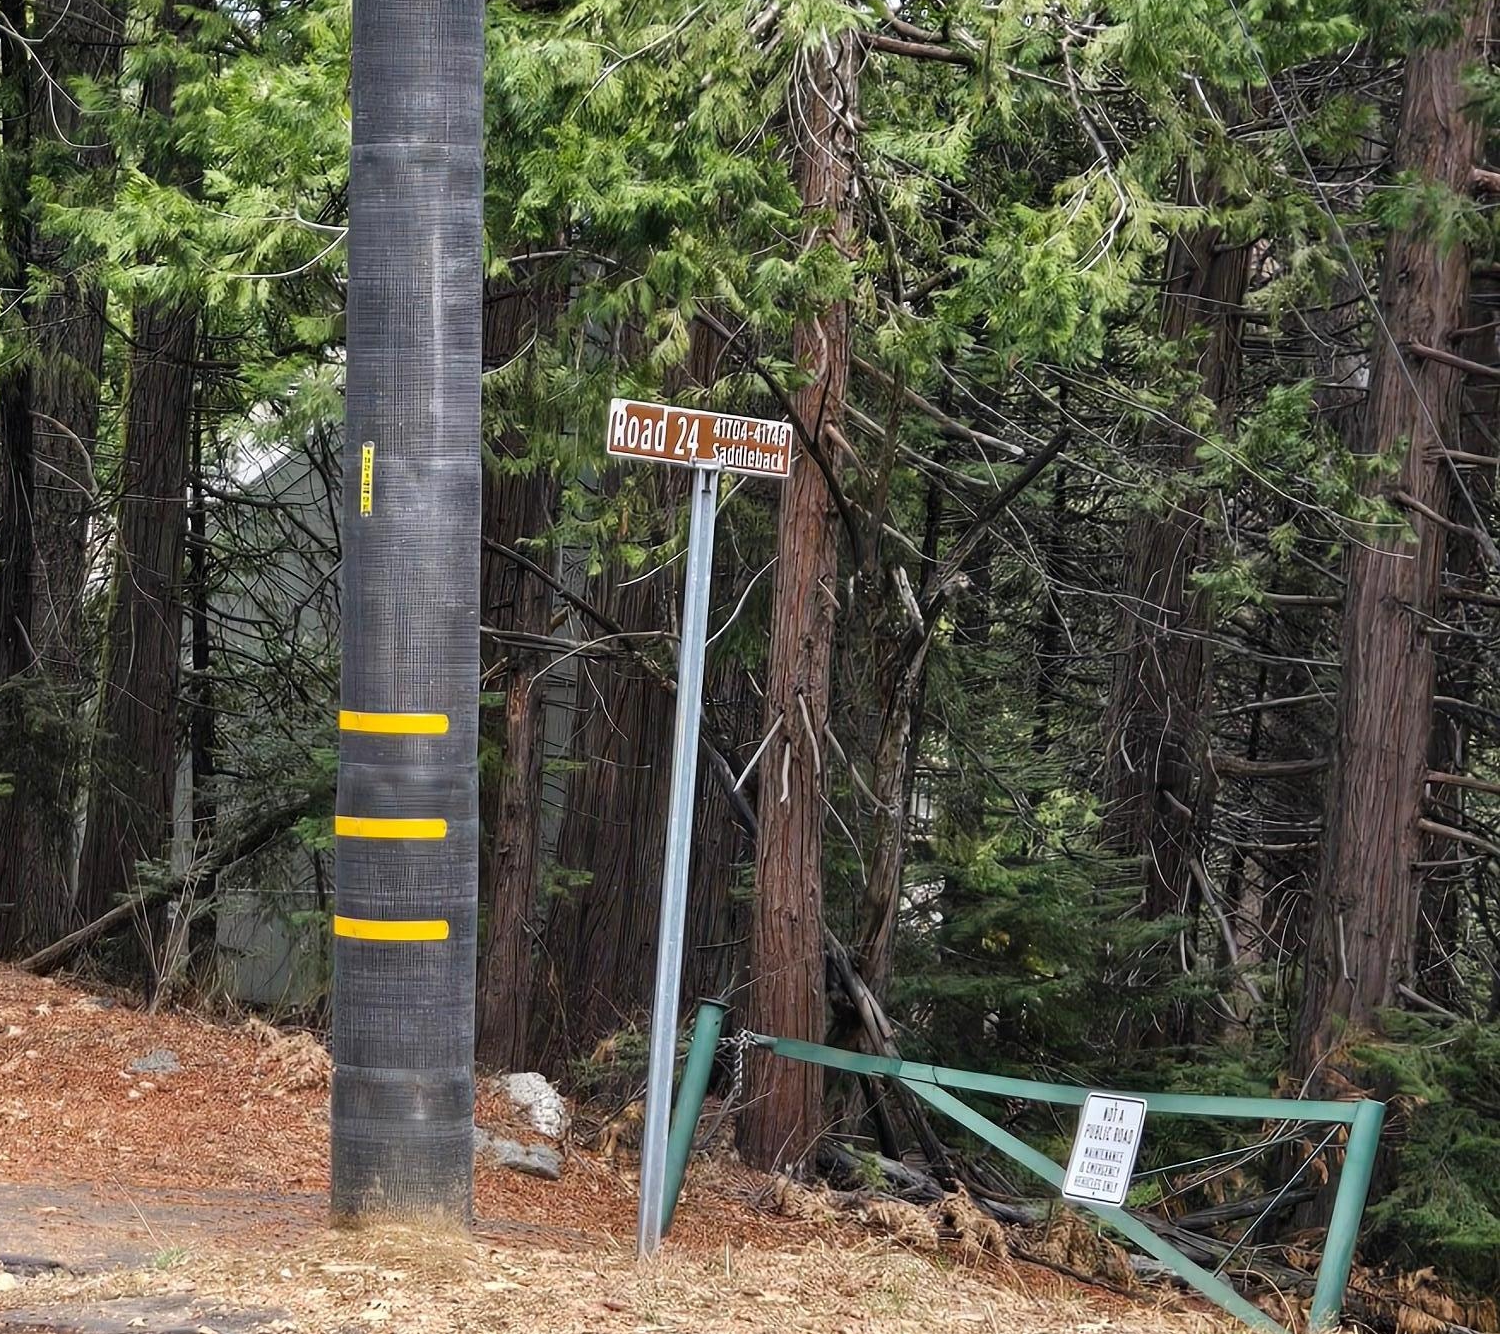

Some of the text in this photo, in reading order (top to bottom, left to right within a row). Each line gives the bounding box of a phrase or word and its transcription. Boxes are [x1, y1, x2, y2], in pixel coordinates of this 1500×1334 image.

[613, 407, 700, 457] Road 24
[712, 417, 787, 447] 41704-41748
[712, 442, 785, 471] Saddleback
[1103, 1107, 1124, 1123] NOT A
[1084, 1123, 1134, 1144] PUBLIC ROAD
